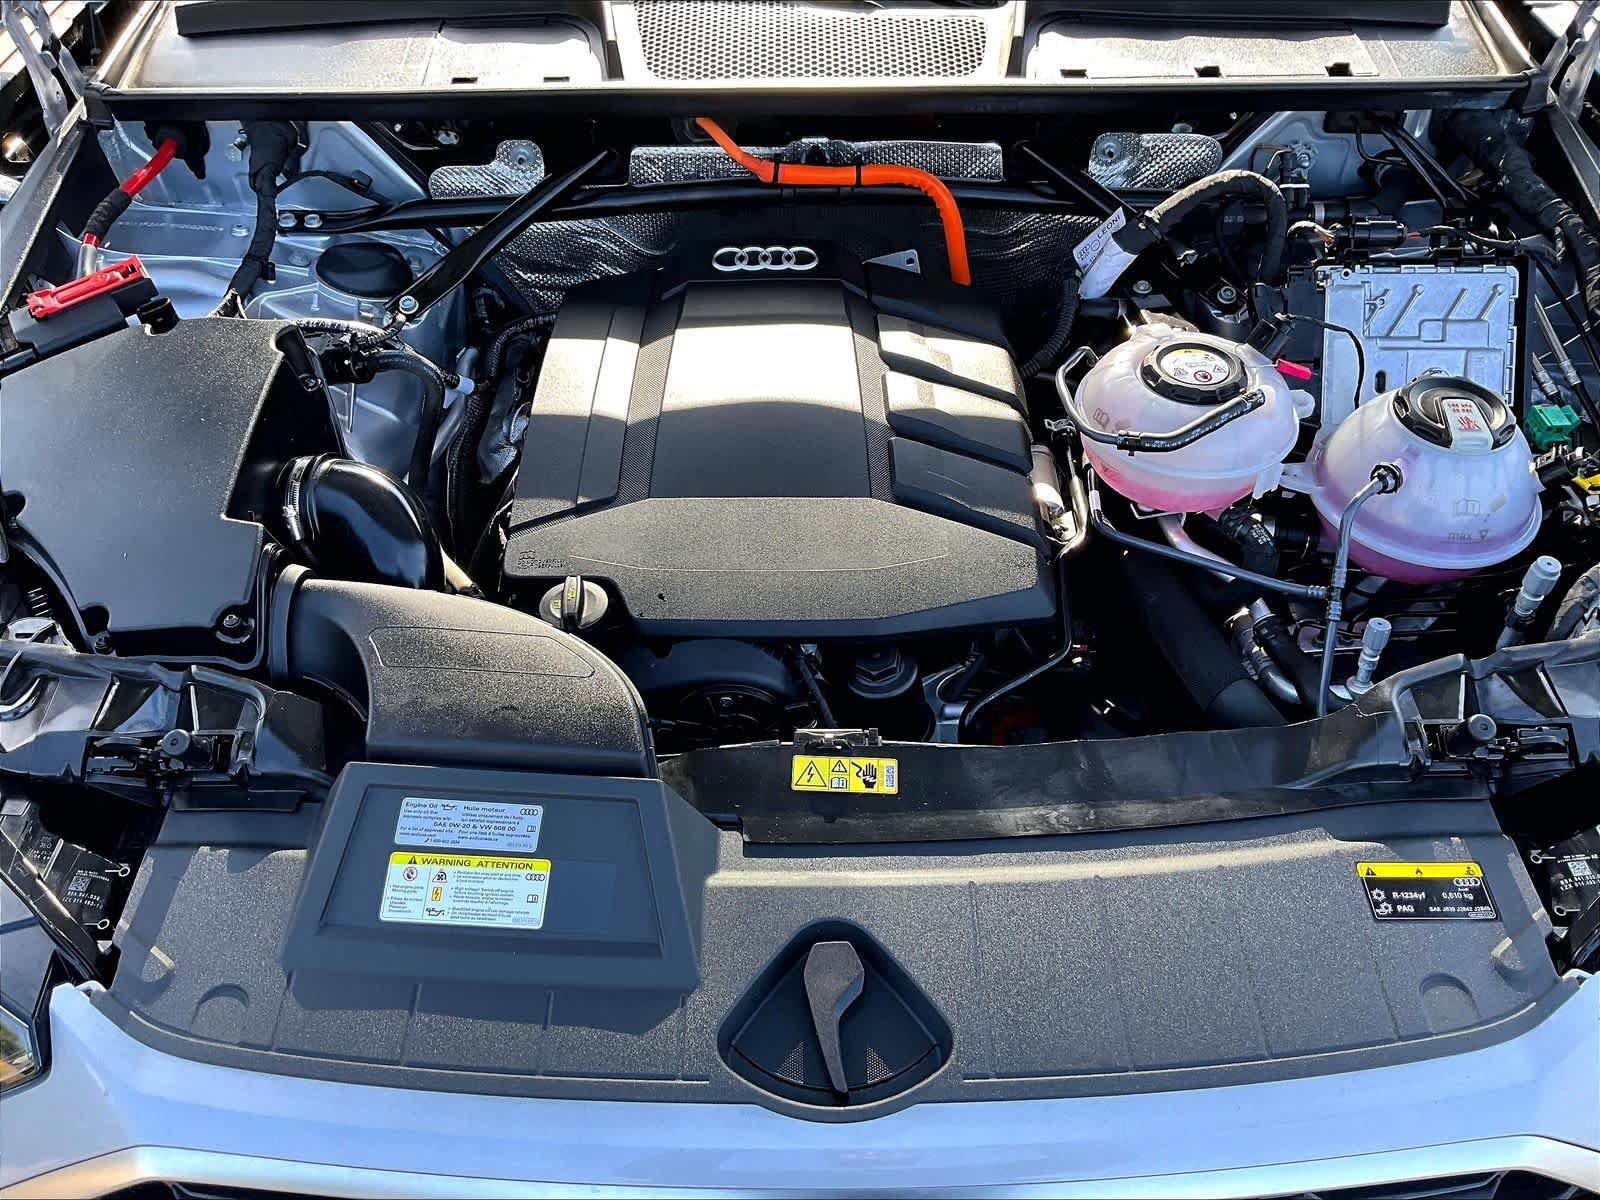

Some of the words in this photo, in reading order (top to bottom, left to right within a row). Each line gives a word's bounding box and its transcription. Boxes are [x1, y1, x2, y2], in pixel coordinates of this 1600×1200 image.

[1097, 214, 1121, 239] LEONI
[406, 802, 427, 810] Engine
[421, 857, 471, 867] WARNING
[476, 859, 534, 870] ATTENTION
[1397, 904, 1415, 912] PAG
